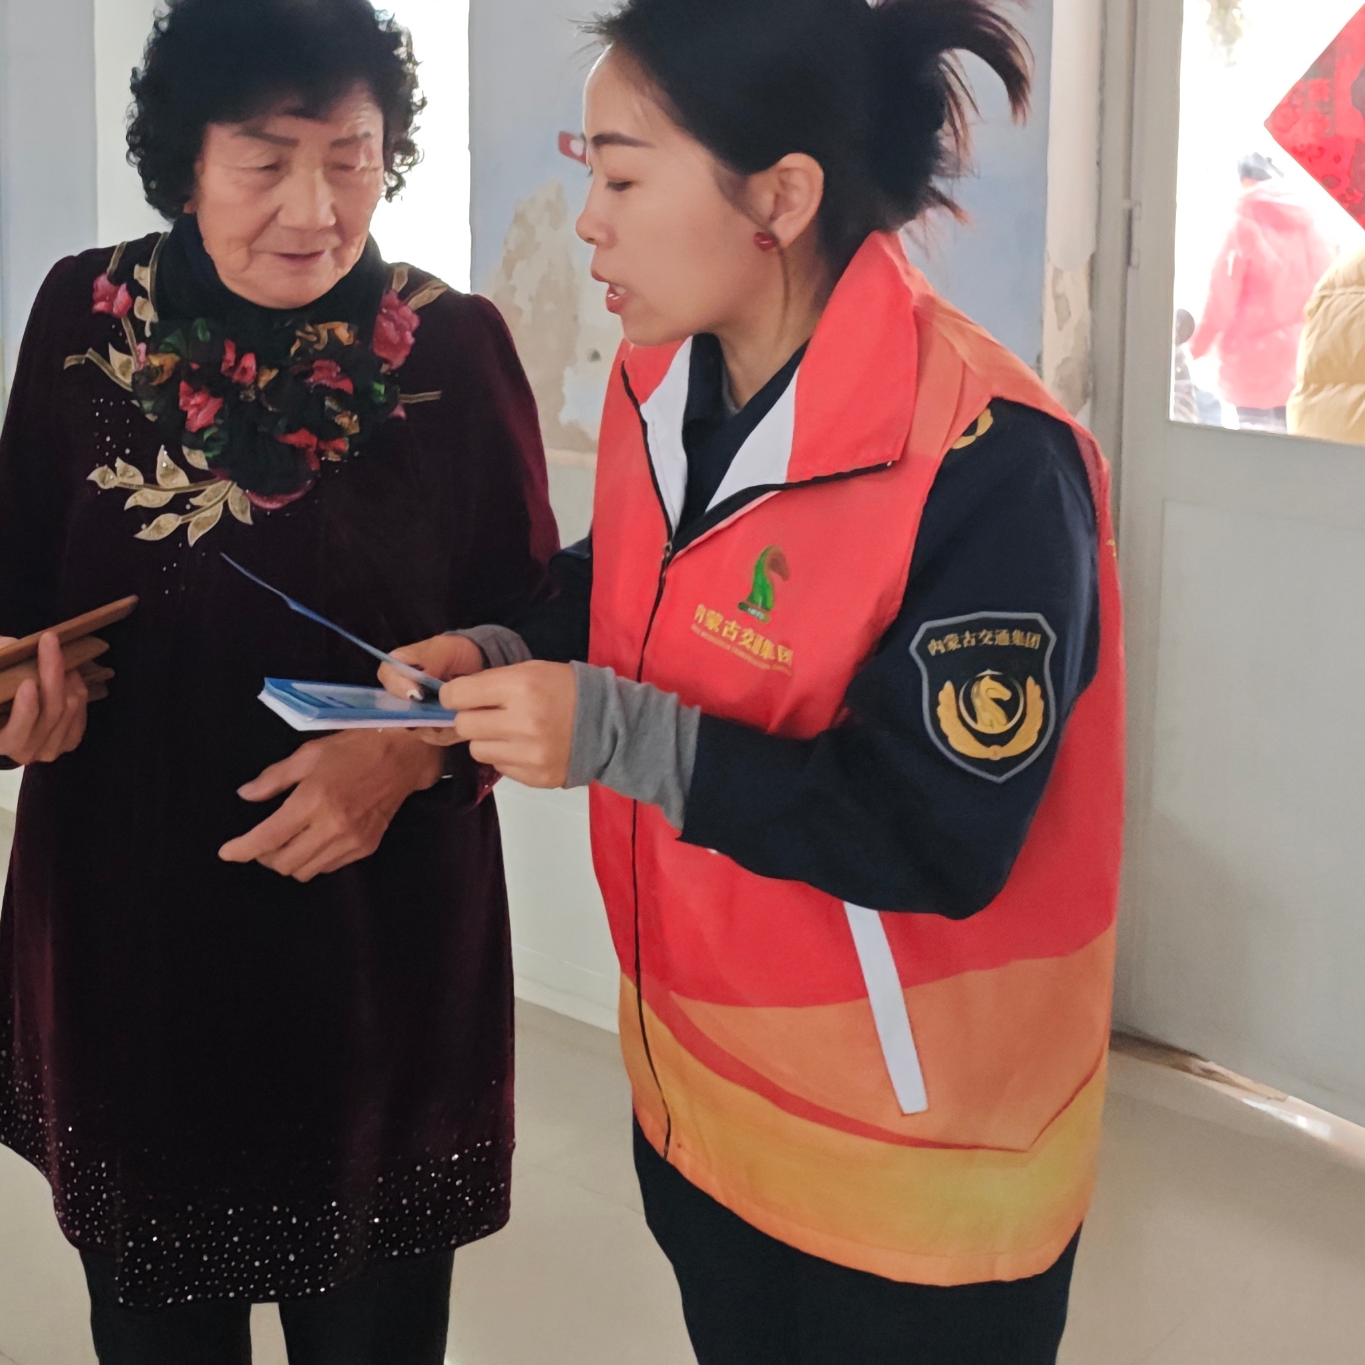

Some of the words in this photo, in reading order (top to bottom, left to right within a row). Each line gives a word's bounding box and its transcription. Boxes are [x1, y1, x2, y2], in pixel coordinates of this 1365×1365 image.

[927, 628, 1042, 657] 内蒙古交通集团
